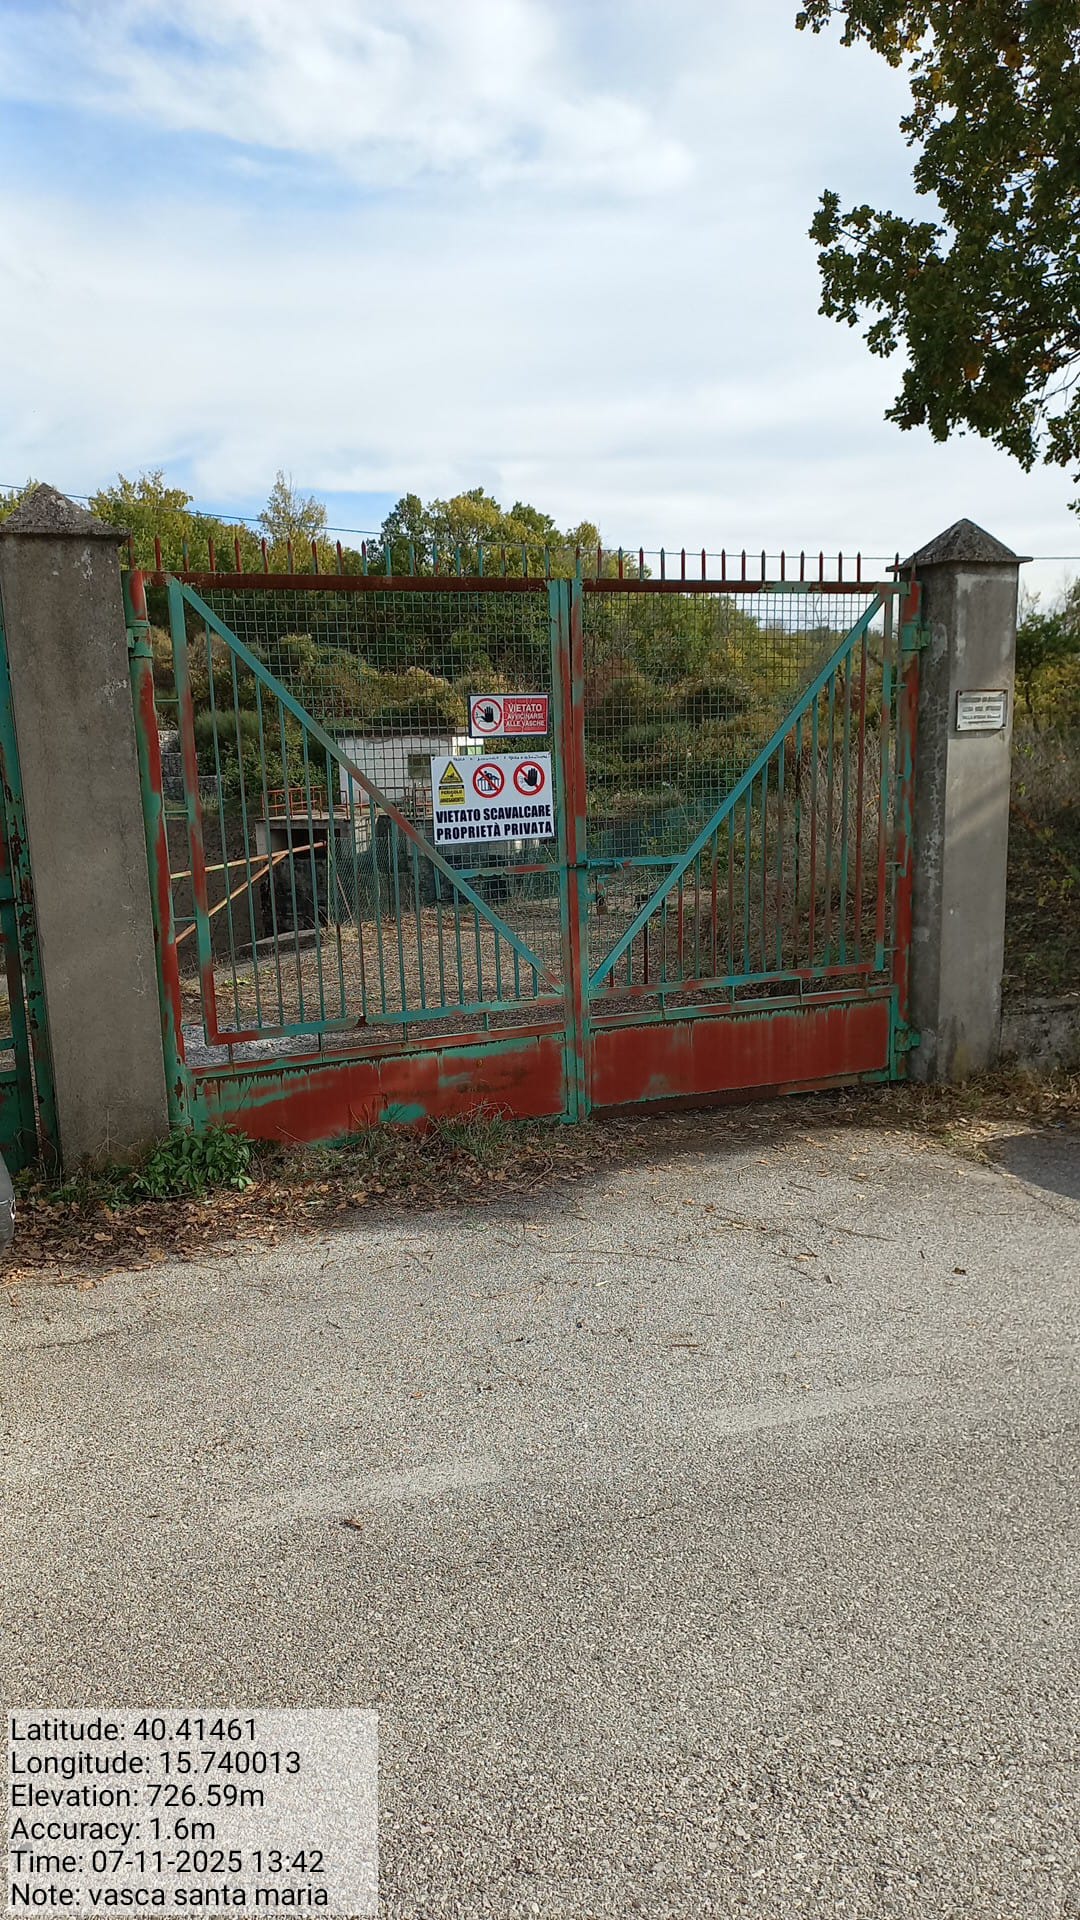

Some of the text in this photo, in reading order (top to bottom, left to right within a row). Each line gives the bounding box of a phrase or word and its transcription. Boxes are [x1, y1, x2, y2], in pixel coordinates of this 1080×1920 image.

[508, 703, 542, 712] VIETATO
[507, 712, 544, 720] AVVICINARSI
[436, 804, 551, 823] VIETATO SCAVALCARE
[436, 821, 552, 840] PROPRIETÀ PRIVATA
